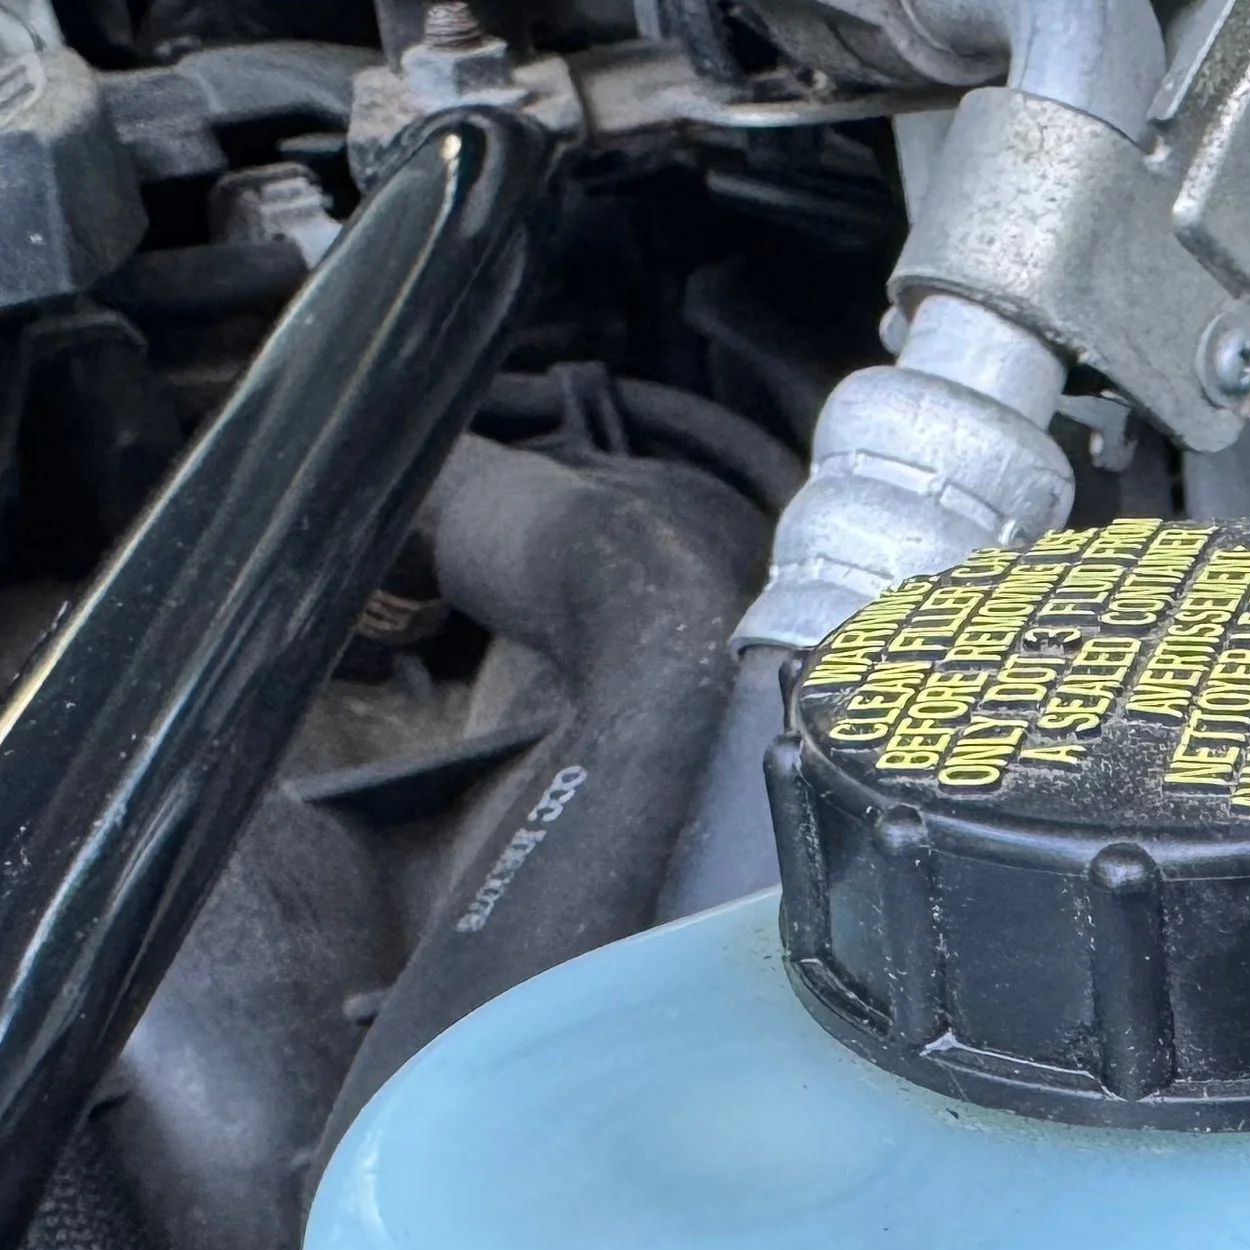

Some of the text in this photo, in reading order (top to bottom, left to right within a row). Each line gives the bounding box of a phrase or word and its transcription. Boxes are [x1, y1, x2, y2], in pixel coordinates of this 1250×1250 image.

[826, 547, 1020, 742] CLEAN FILLER CAP
[875, 671, 990, 770] BEFORE
[1023, 527, 1100, 556] USE
[938, 517, 1164, 786] ONLY DOT 3 FLUID FROM
[1038, 636, 1142, 731] SEALED
[1018, 744, 1087, 766] A
